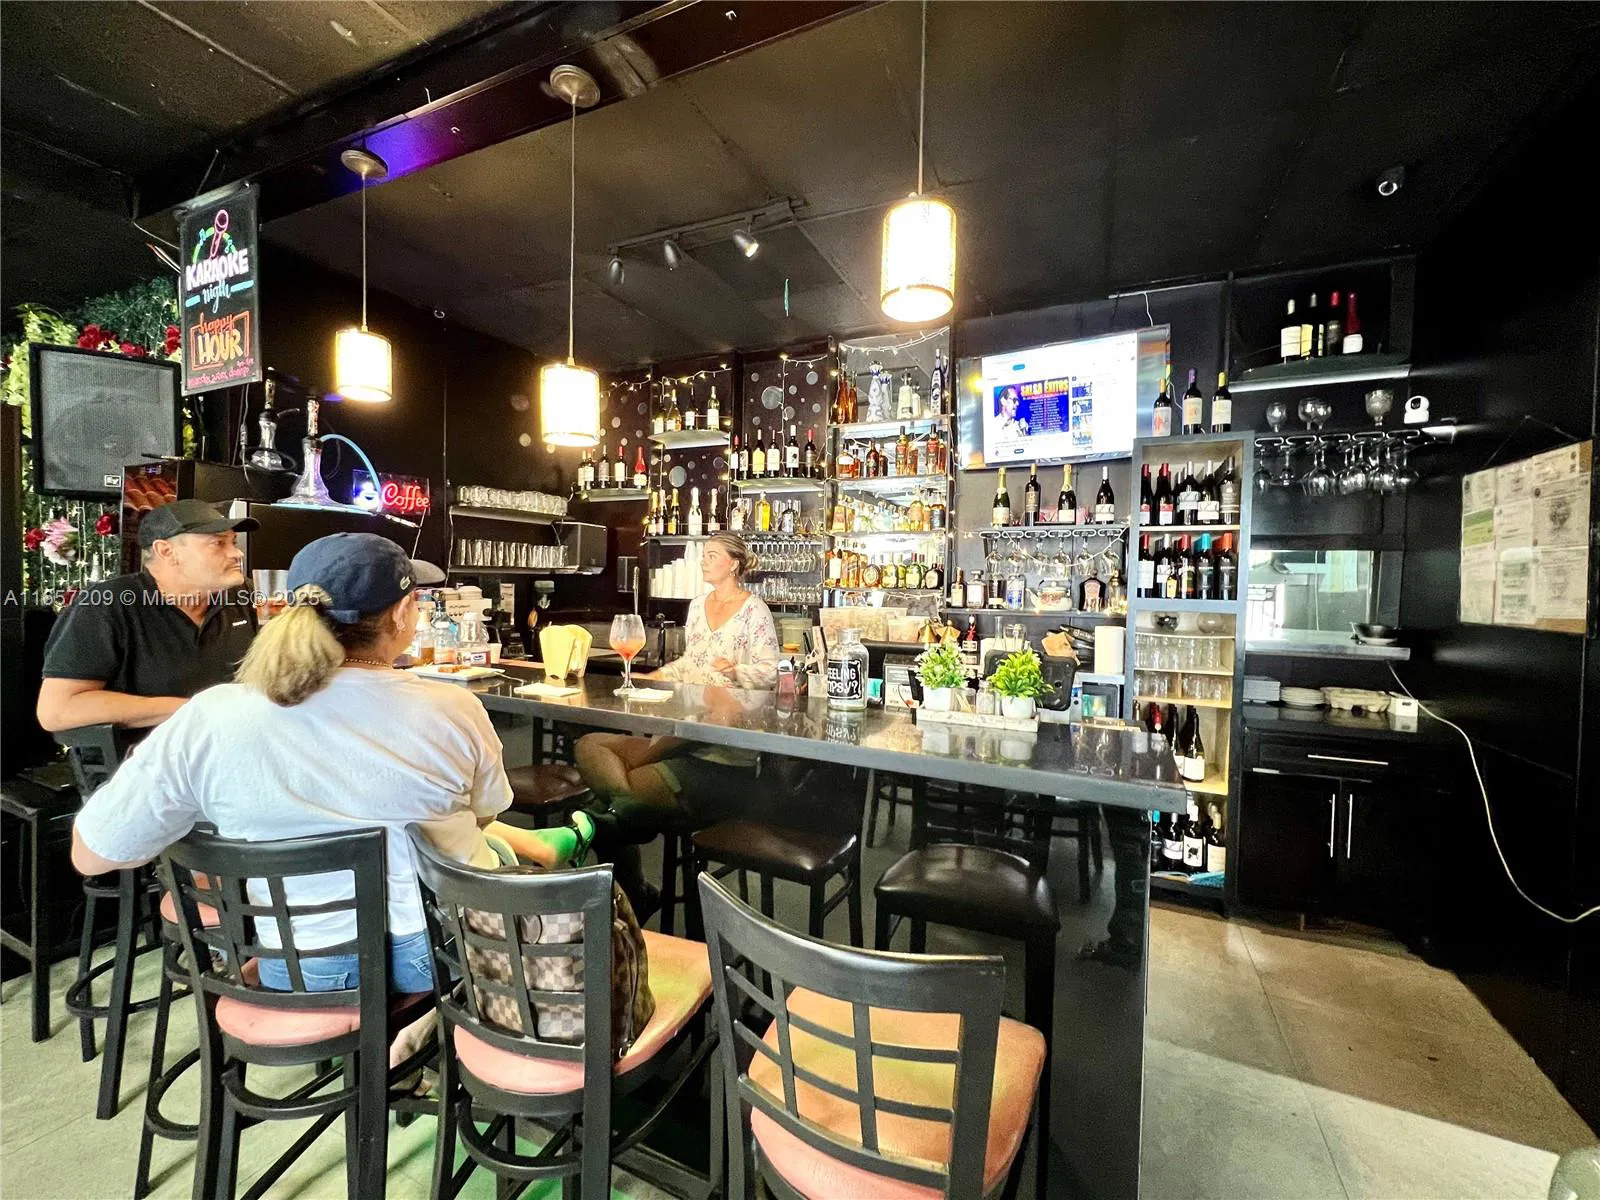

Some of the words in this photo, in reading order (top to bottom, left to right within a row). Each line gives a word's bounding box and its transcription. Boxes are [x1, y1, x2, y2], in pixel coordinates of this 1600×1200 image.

[186, 248, 249, 291] KARAOKE
[200, 312, 235, 335] happy
[197, 329, 243, 365] HOUR
[382, 483, 429, 510] Coffee
